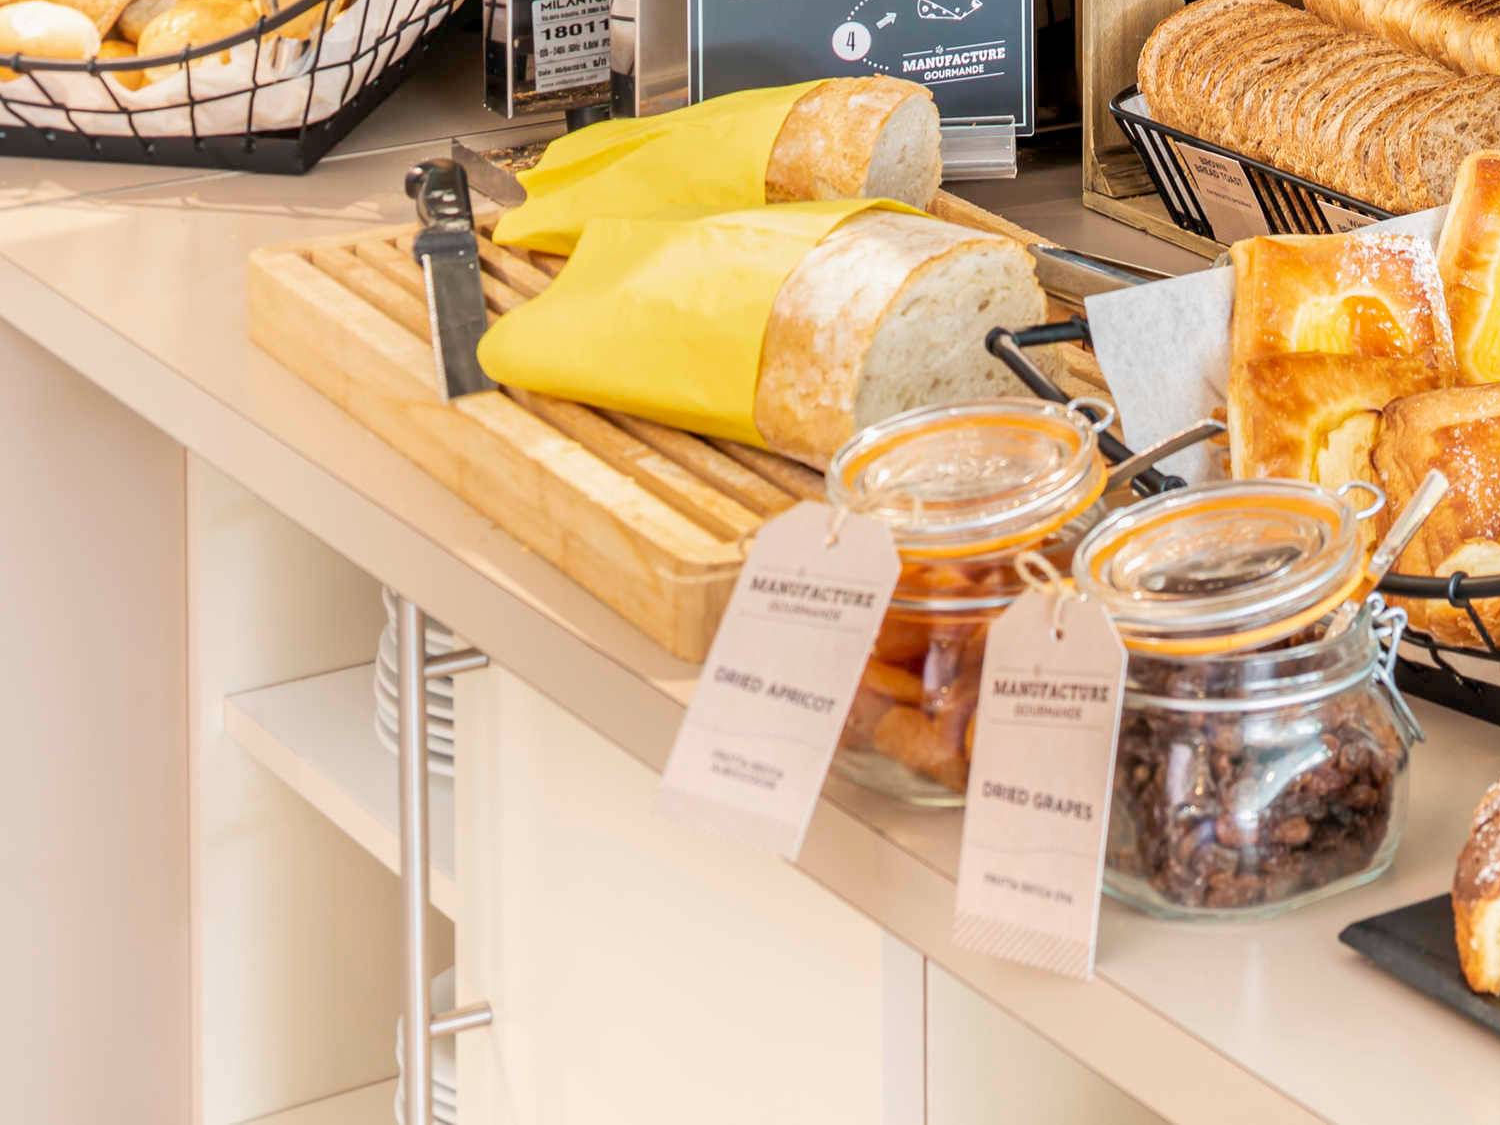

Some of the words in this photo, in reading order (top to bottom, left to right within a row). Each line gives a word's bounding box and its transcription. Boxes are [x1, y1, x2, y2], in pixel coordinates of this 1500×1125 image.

[845, 31, 856, 52] 4
[902, 47, 1006, 73] MANUFACTURE
[923, 64, 985, 80] GOURMANDE
[749, 575, 877, 610] MANUFACTURE
[714, 665, 763, 695] DRIED
[766, 681, 837, 716] APRICOT
[992, 678, 1111, 703] MANUFACTURE
[982, 780, 1031, 806] DRIED
[1033, 791, 1093, 821] GRAPES
